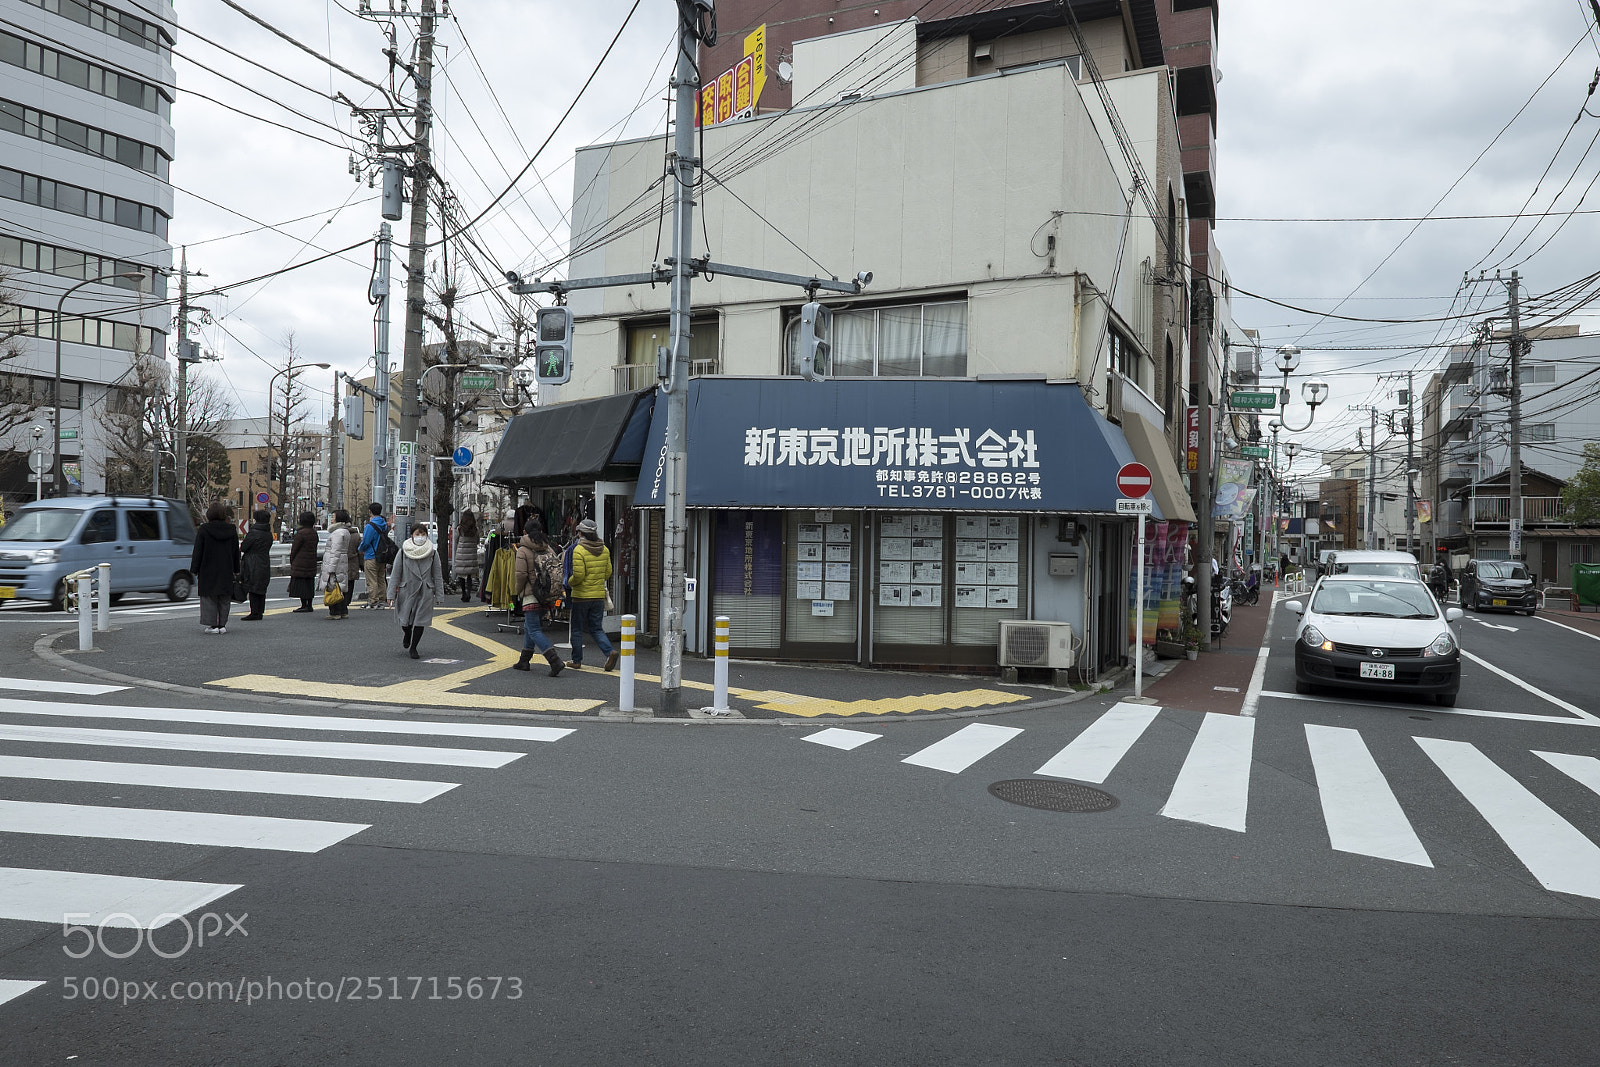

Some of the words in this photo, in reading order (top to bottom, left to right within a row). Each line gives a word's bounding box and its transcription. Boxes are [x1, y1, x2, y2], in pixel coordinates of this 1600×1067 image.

[719, 73, 732, 122] 取付
[736, 62, 750, 112] 合鍵
[1233, 396, 1274, 405] 昭和大学通り
[744, 427, 1041, 468] 新東京地所株式会社
[1118, 502, 1151, 512] 自転車を除く
[743, 521, 754, 596] 新東京地所株式会社
[1368, 669, 1393, 678] 74-88
